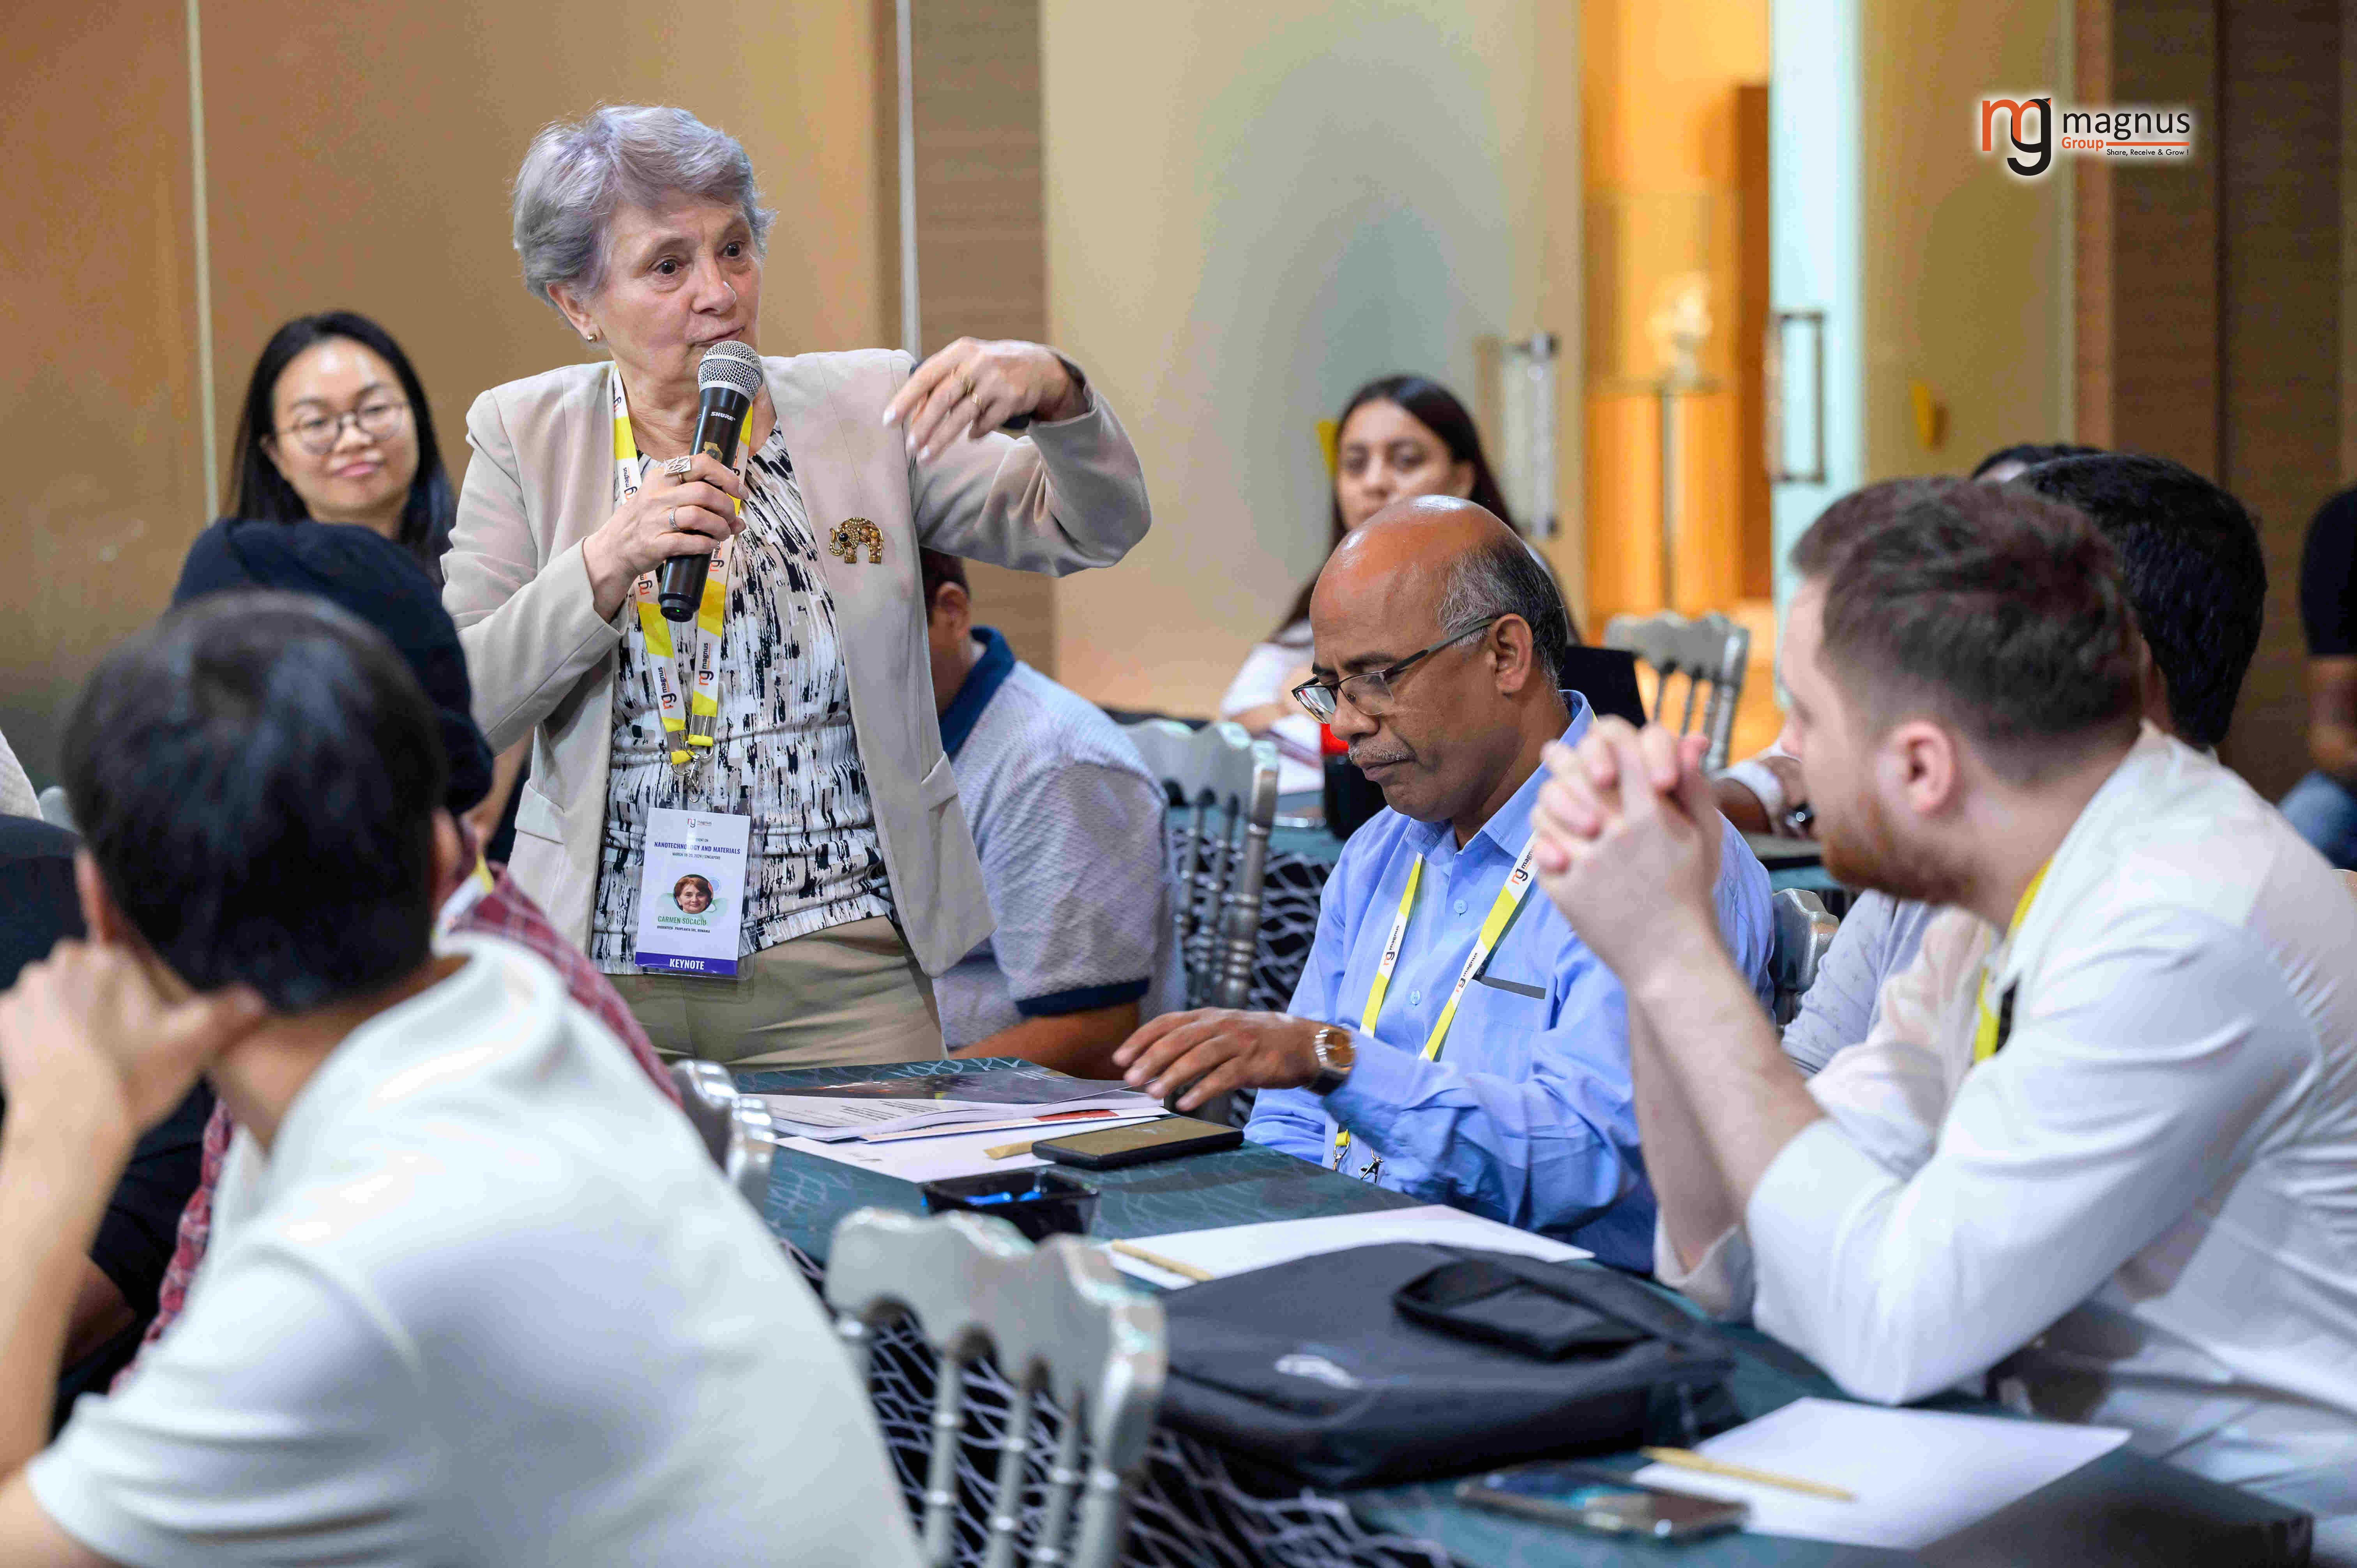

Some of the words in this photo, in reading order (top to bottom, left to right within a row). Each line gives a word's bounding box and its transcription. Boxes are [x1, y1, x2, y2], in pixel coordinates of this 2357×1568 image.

[710, 411, 734, 421] SHURE
[658, 666, 668, 692] magnus
[654, 842, 700, 851] NANOTECHNOOGY
[682, 918, 707, 926] SOCACIU
[1389, 925, 1399, 950] magnus
[670, 958, 705, 970] KEYNOTE
[1463, 952, 1478, 977] magnus
